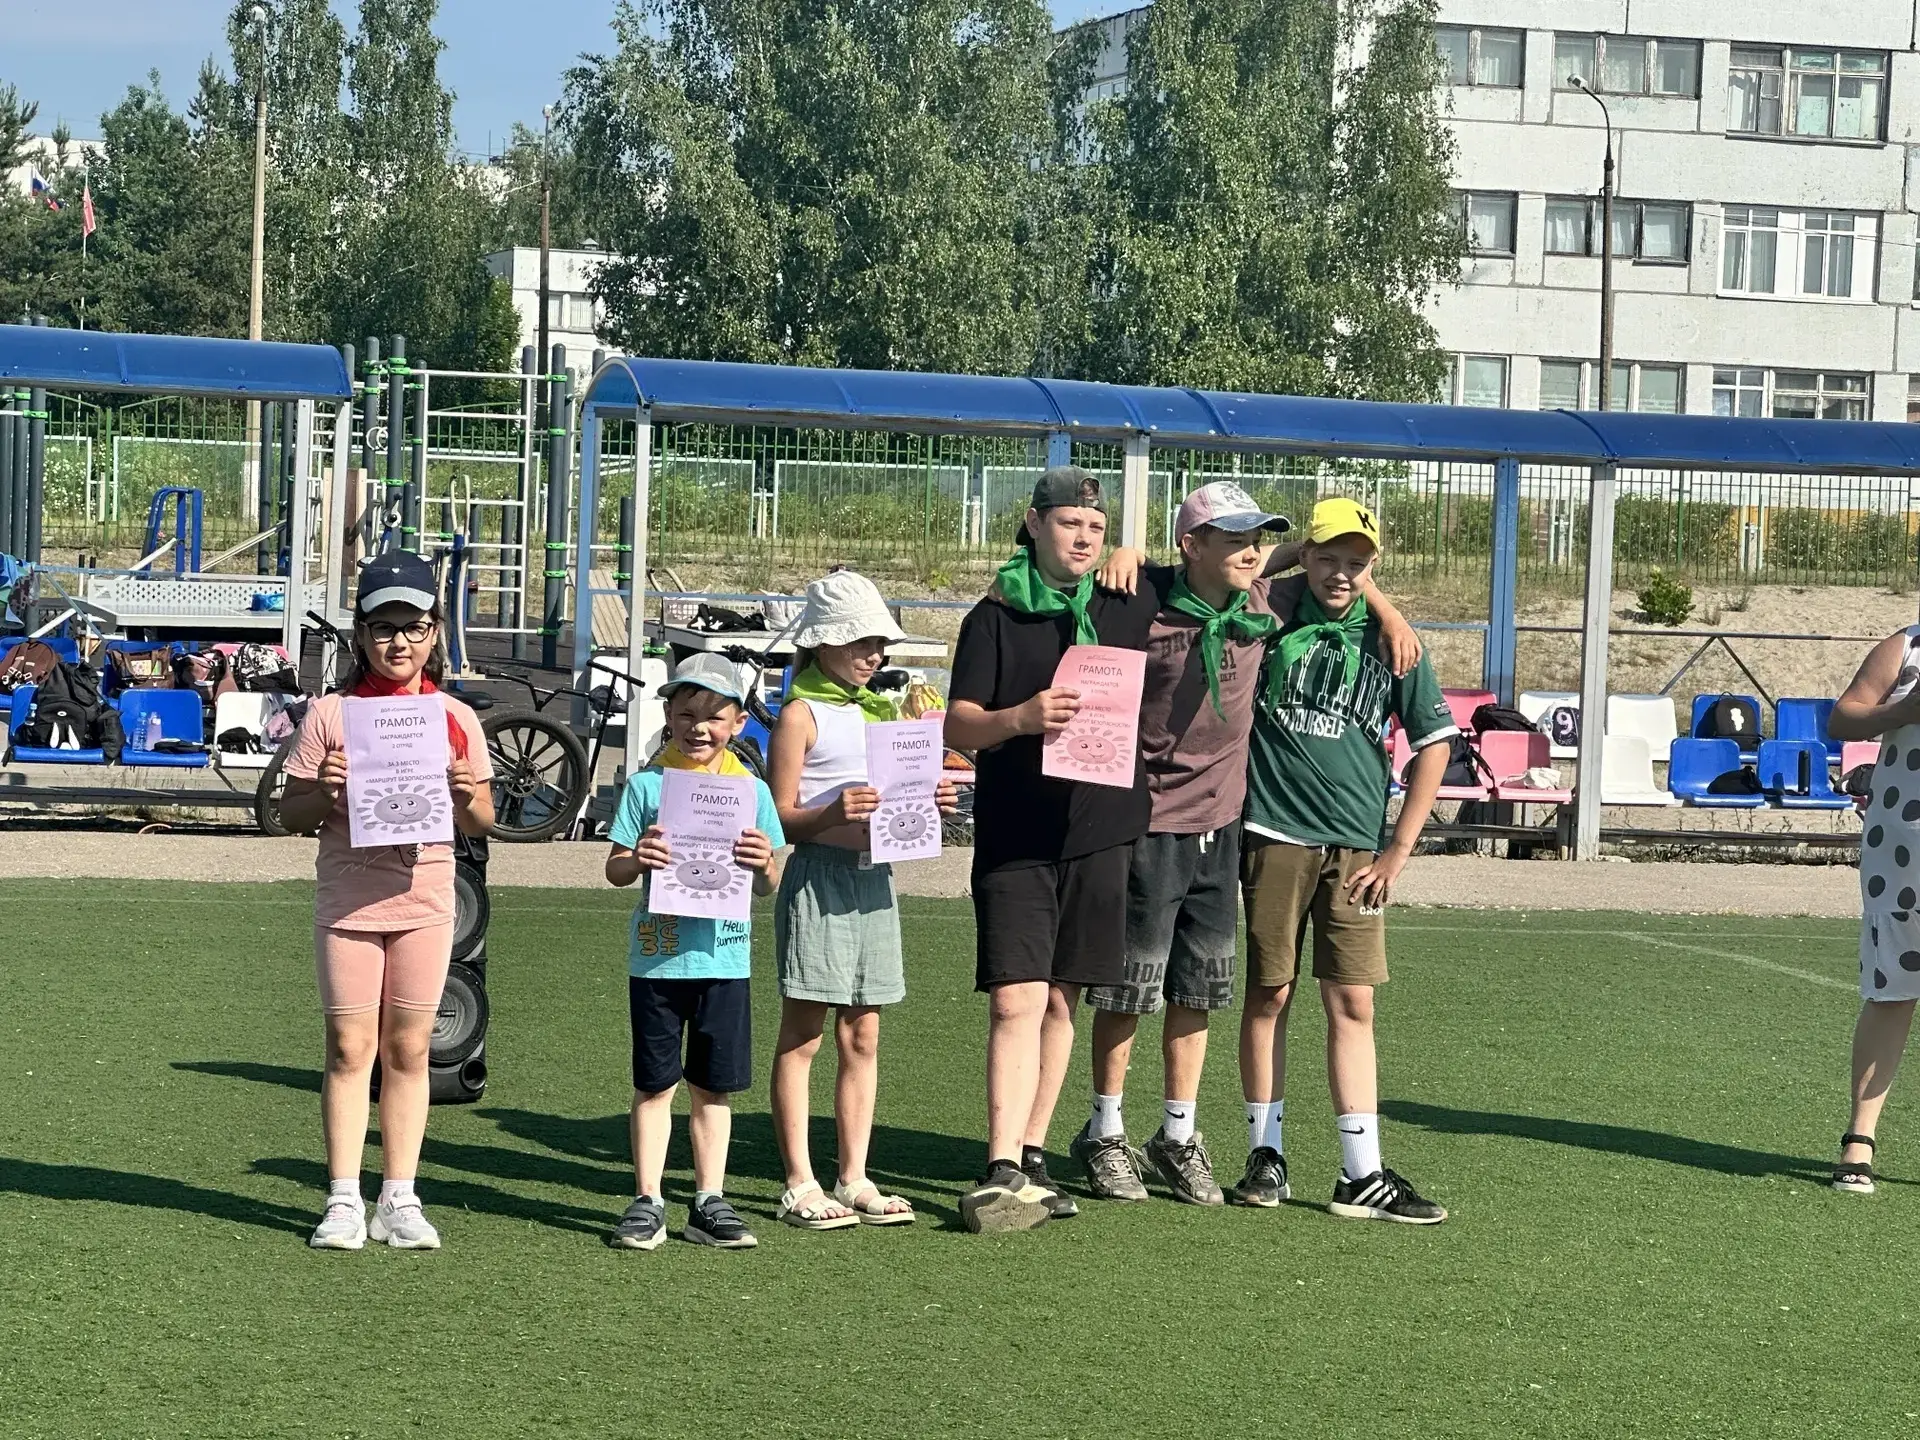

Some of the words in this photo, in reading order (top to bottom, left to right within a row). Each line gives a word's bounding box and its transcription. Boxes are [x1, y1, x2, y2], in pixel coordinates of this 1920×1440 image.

[1356, 510, 1376, 532] K
[1078, 664, 1122, 676] ГРАМОТА
[374, 716, 426, 728] ГРАМОТА
[1290, 708, 1346, 739] YOURSELF
[892, 740, 930, 750] ГРАМОТА
[690, 793, 740, 806] ГРАМОТА
[693, 810, 735, 818] НАГРАЖДАЕТСЯ
[637, 916, 658, 956] WE
